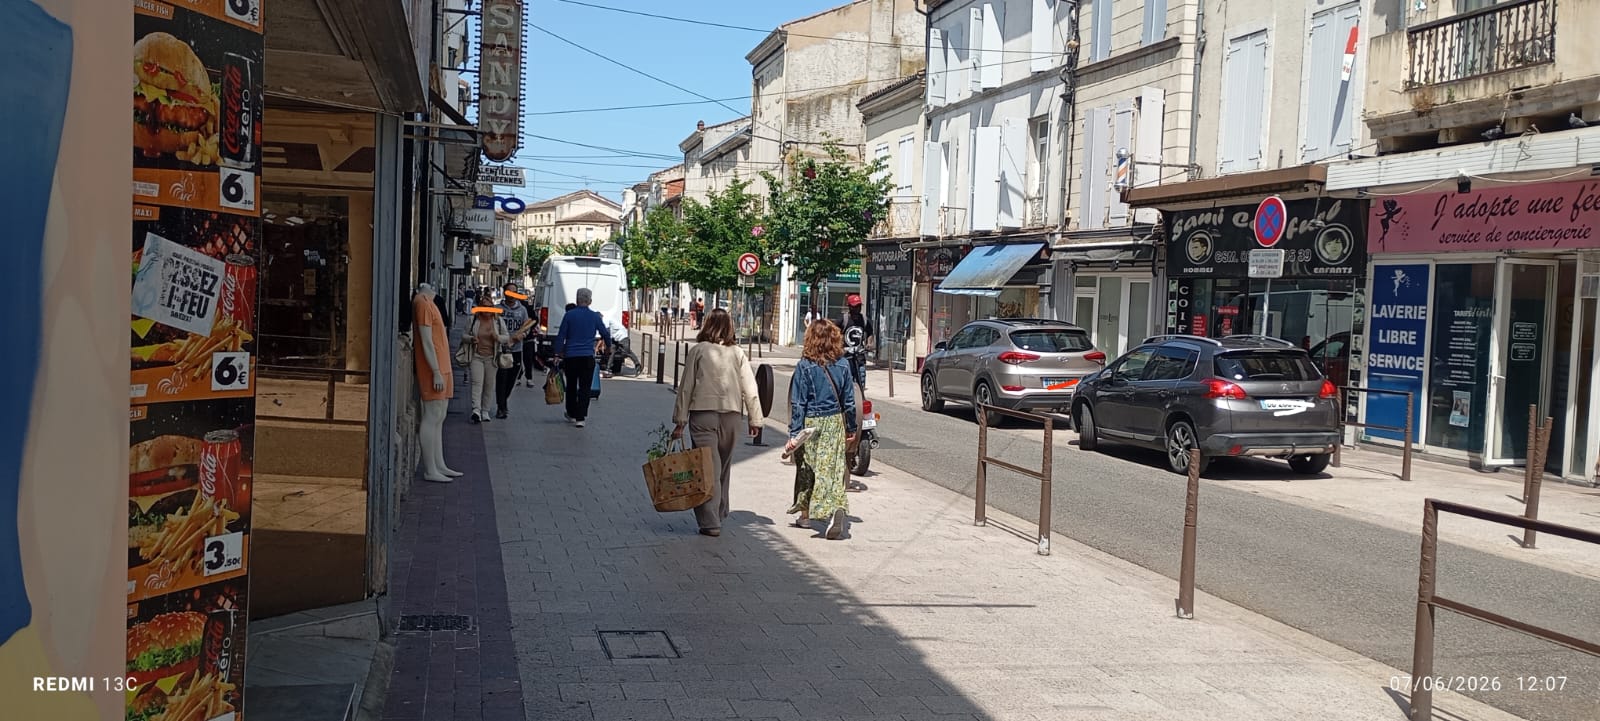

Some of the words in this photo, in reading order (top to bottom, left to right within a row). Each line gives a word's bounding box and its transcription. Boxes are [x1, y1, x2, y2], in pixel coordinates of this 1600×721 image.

[487, 4, 515, 143] SANDY
[242, 89, 250, 136] zero
[135, 208, 152, 217] MAXI
[1431, 193, 1519, 231] J'adopte
[1527, 197, 1564, 214] une
[1440, 229, 1481, 243] service
[1485, 226, 1502, 242] de
[1507, 224, 1592, 247] conciergerie
[1372, 304, 1427, 320] LAVERIE
[1378, 329, 1417, 345] LIBRE
[1369, 353, 1424, 371] SERVICE
